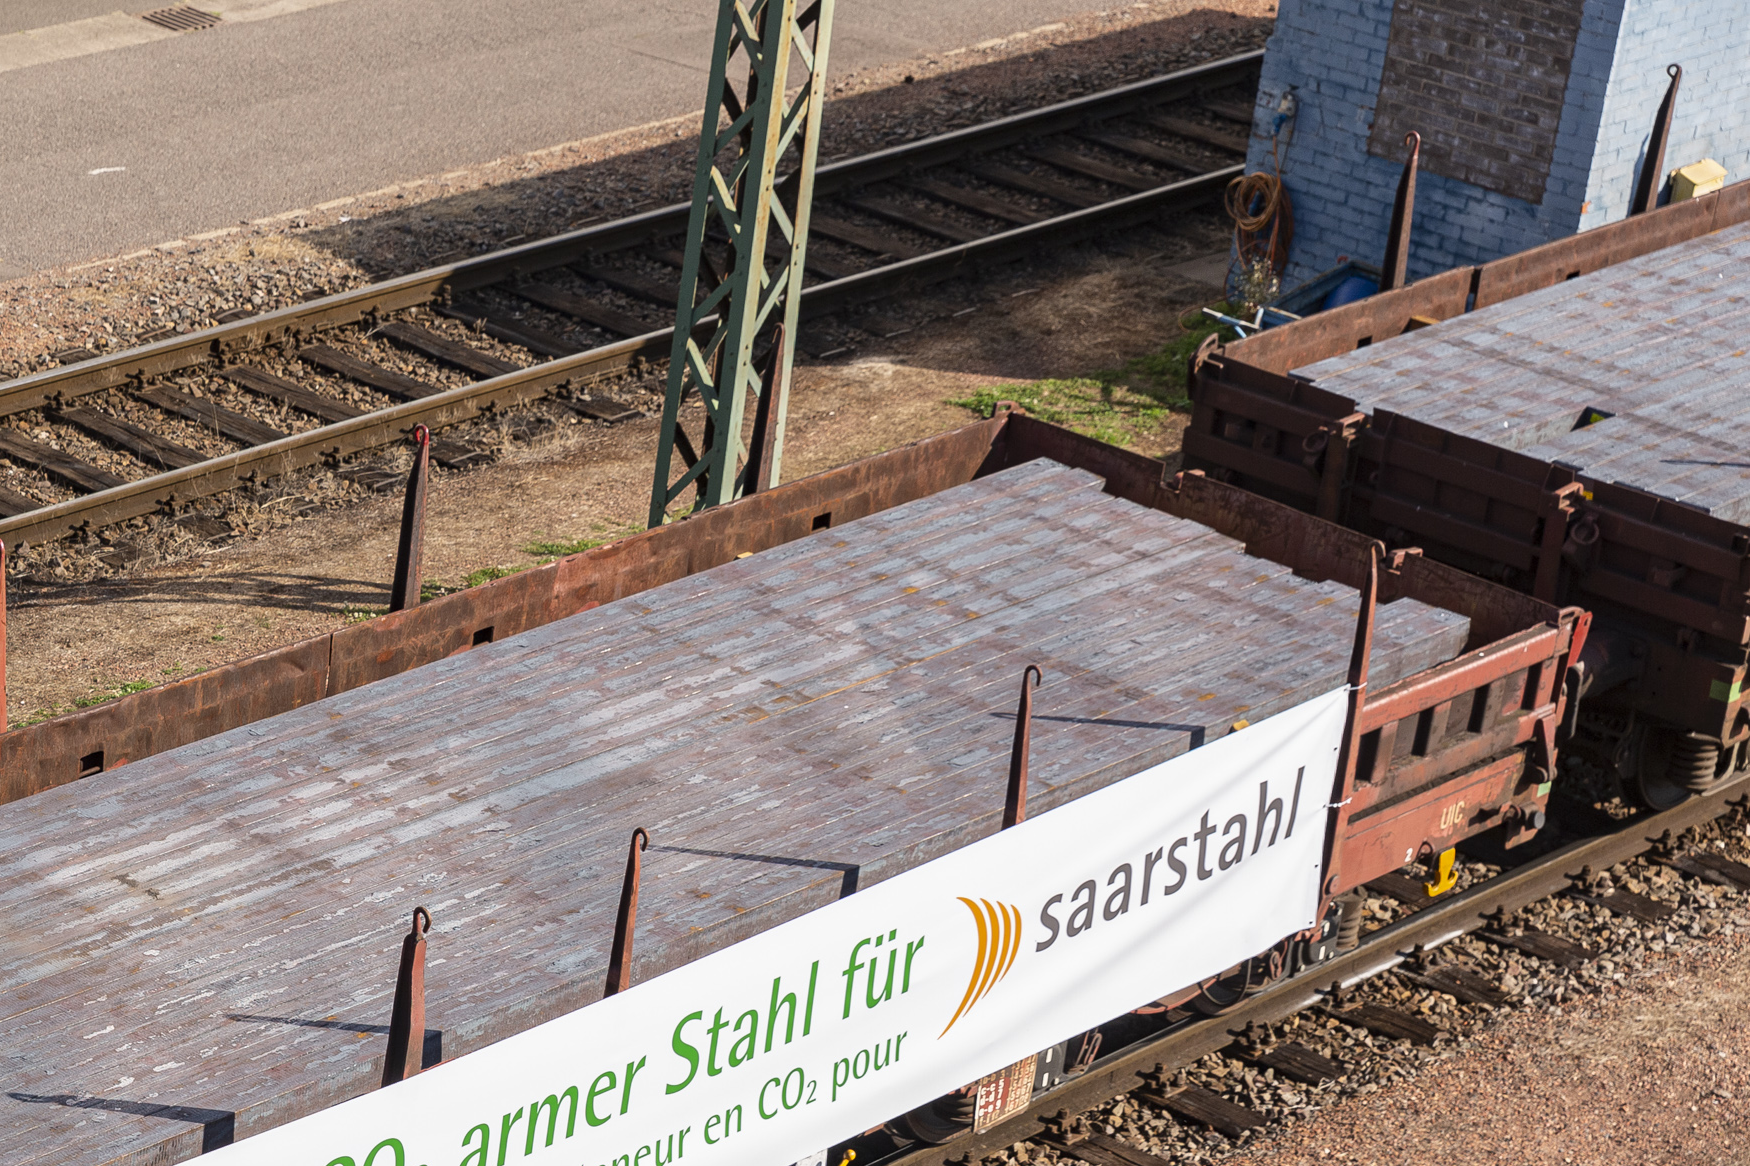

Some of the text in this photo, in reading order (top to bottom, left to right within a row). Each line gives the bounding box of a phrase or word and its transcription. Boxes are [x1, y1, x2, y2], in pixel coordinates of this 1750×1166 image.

[1035, 765, 1306, 953] saarstahl
[1440, 801, 1465, 829] UIC
[665, 960, 819, 1096] Stahl
[842, 928, 925, 1021] für
[704, 1104, 742, 1145] en
[832, 1031, 908, 1102] pour
